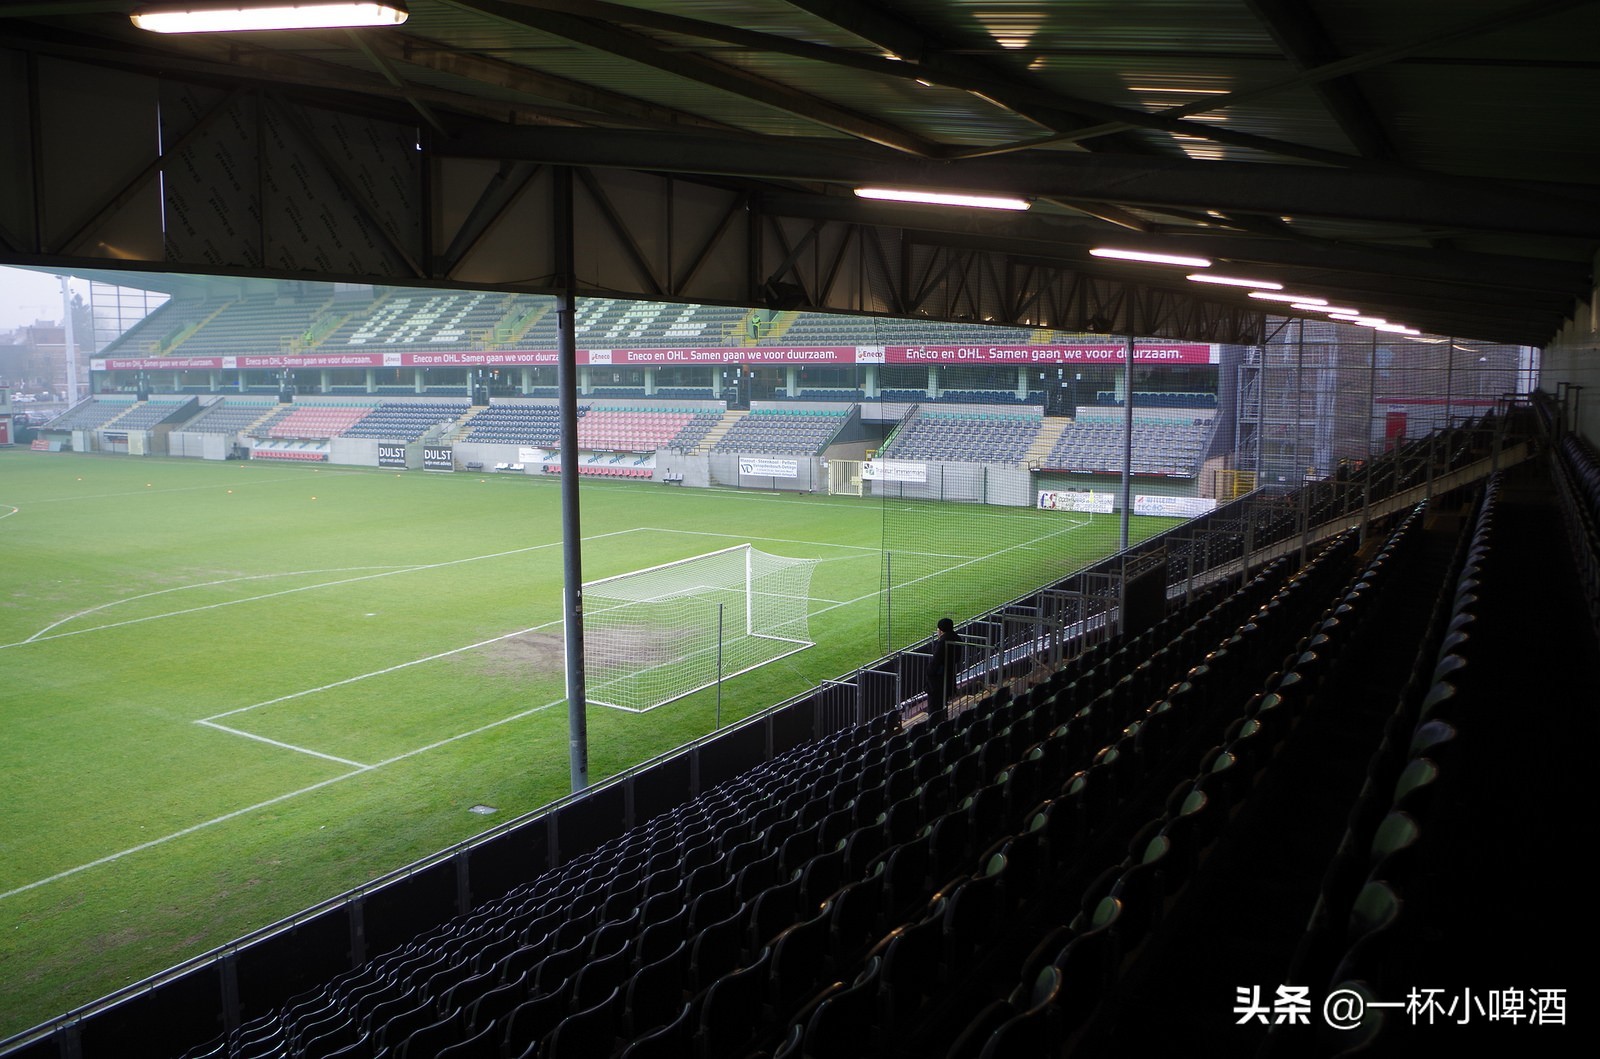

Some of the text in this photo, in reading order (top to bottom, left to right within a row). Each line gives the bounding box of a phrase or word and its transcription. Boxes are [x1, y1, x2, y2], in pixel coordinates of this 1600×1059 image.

[413, 355, 432, 363] Eneco
[443, 354, 460, 362] OHL.
[461, 354, 485, 362] Samen
[486, 355, 503, 364] gaan
[535, 353, 559, 361] duurza
[628, 352, 653, 360] Eneco
[667, 351, 688, 360] OHL.
[691, 351, 721, 360] Samen
[723, 352, 744, 361] gaan
[764, 351, 784, 359] voor
[787, 349, 837, 359] duurzaam.
[906, 349, 938, 358] Eneco
[958, 348, 985, 359] OHL.
[989, 348, 1028, 359] Samen
[1032, 350, 1061, 361] gaan
[1064, 350, 1082, 358] we
[1086, 350, 1113, 358] voor
[304, 358, 318, 366] gaan
[342, 356, 373, 364] duurzaam.
[379, 447, 405, 458] DULST
[424, 450, 452, 460] DULST
